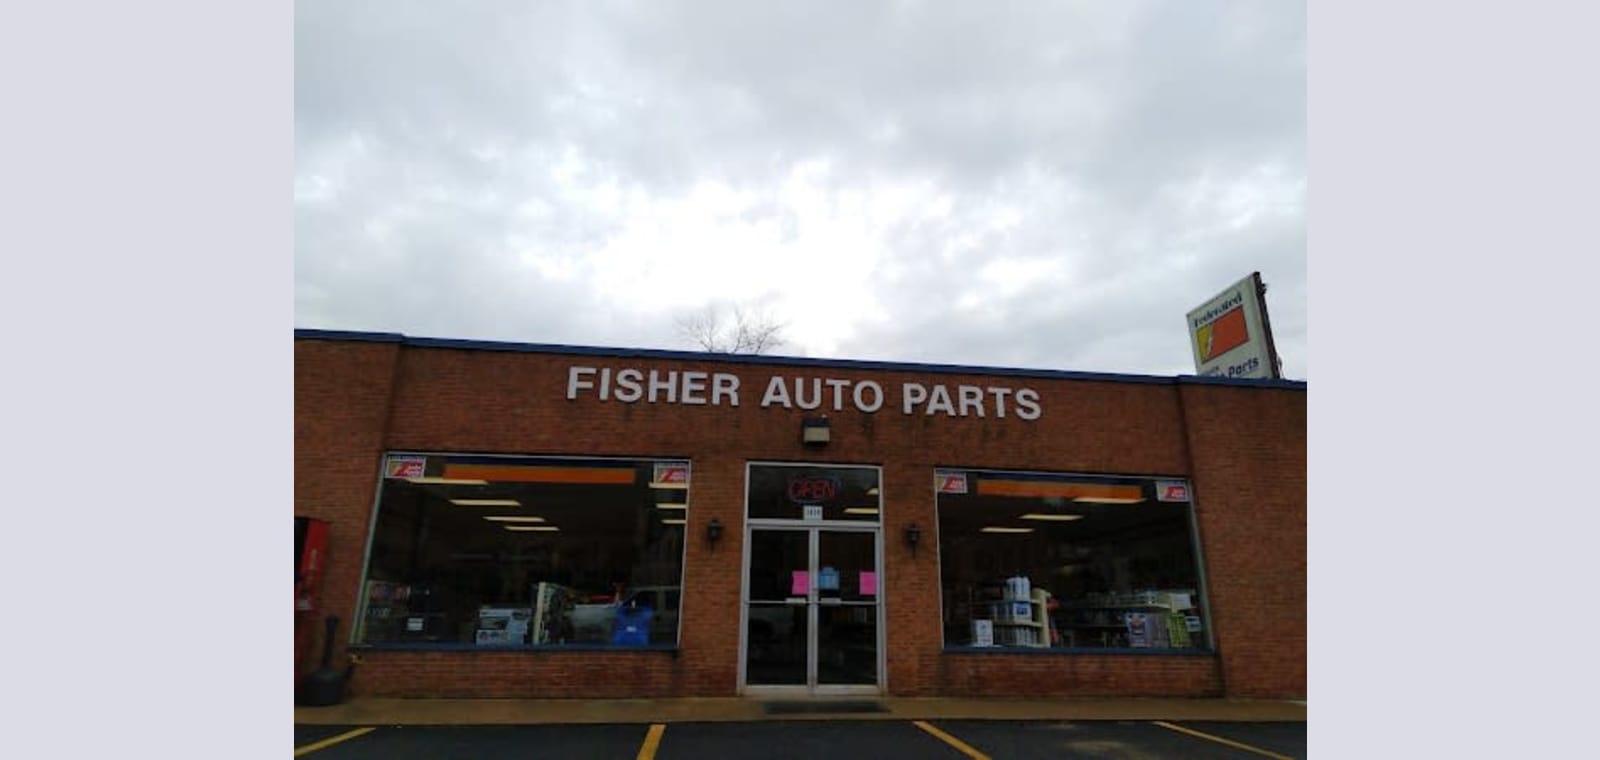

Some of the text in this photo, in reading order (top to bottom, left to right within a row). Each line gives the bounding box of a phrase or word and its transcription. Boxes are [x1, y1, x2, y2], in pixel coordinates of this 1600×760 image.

[567, 367, 1042, 420] FISHER AUTO PARTS
[788, 479, 836, 500] OPEN
